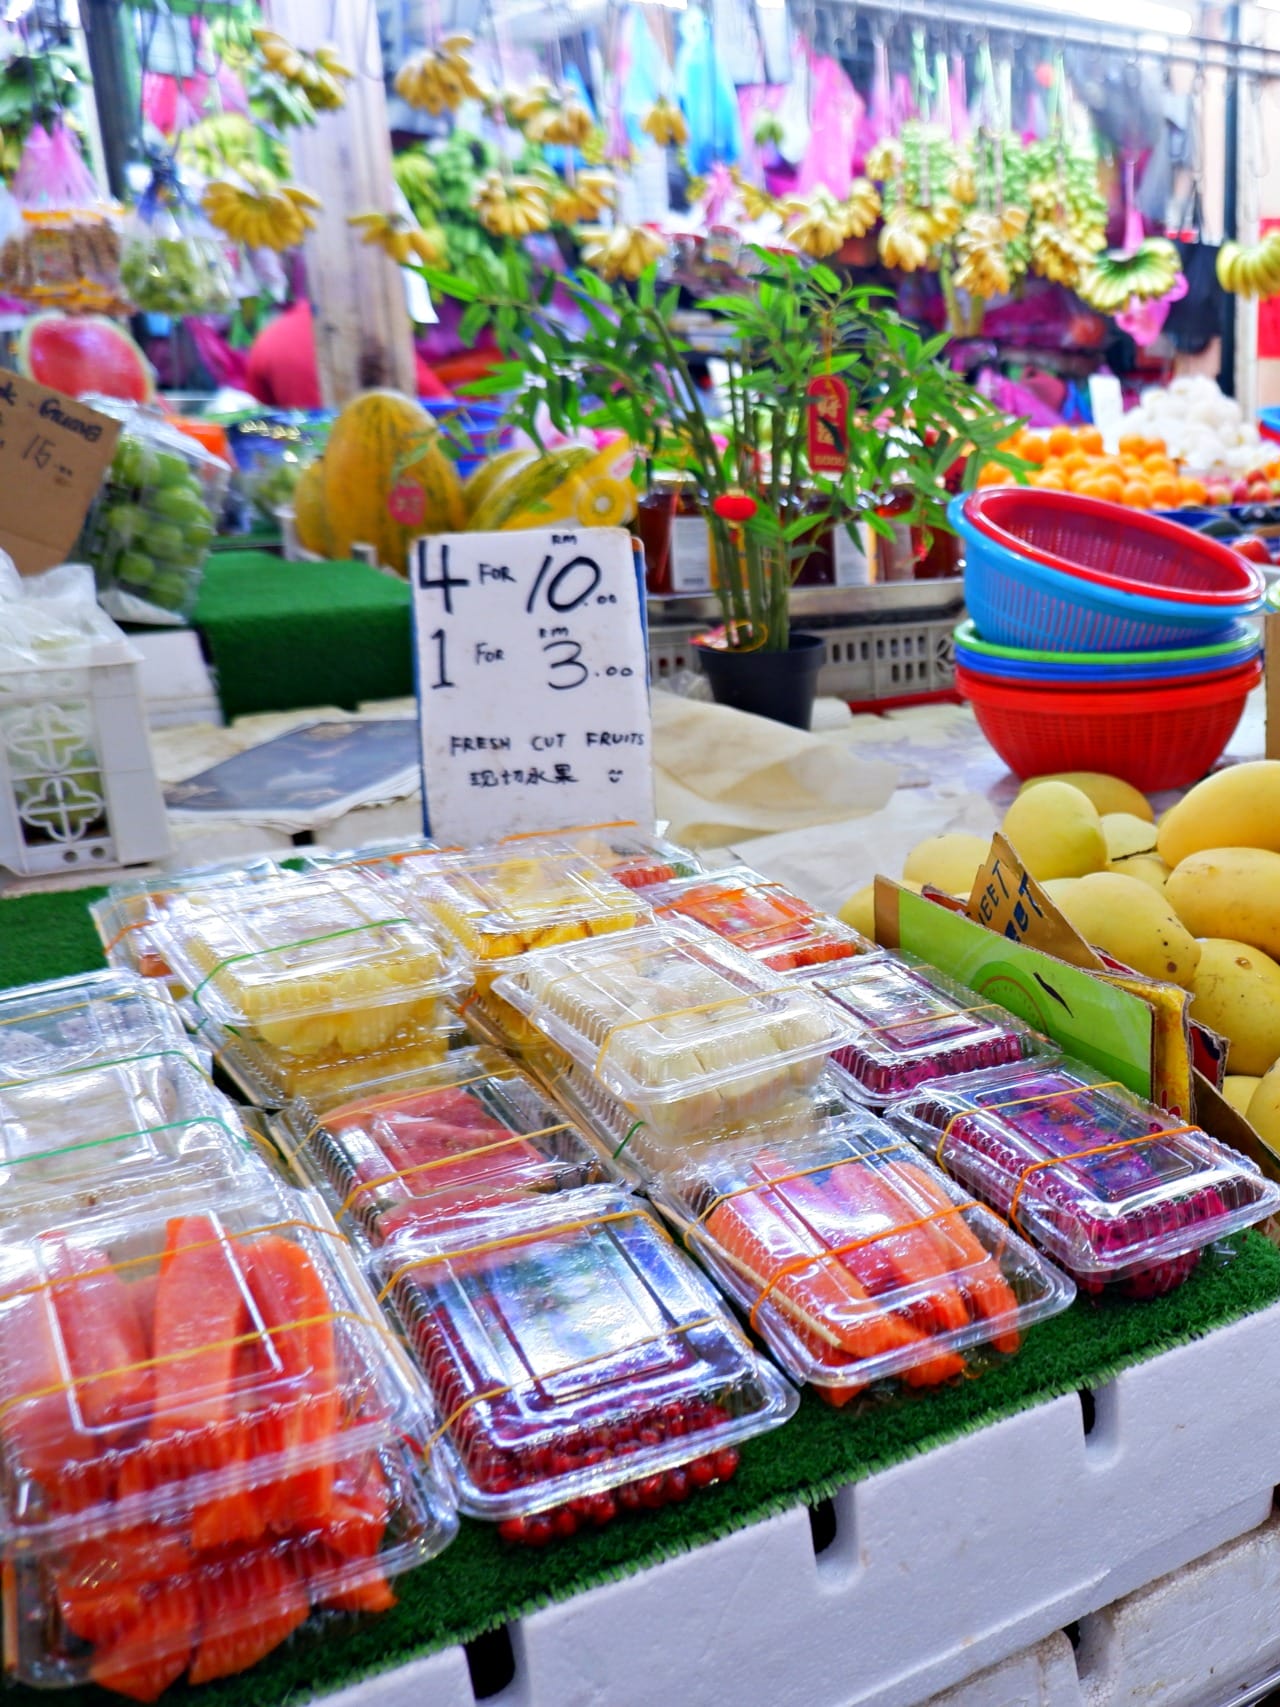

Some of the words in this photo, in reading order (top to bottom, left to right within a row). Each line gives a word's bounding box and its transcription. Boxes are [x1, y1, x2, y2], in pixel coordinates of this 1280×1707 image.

[418, 539, 469, 614] 4
[430, 628, 455, 690] 1
[543, 640, 634, 690] 3.00
[450, 736, 512, 756] FRESH
[531, 733, 567, 751] CUT
[586, 732, 645, 748] FRUITS
[469, 763, 579, 787] 现切水果
[977, 858, 1010, 927] EET
